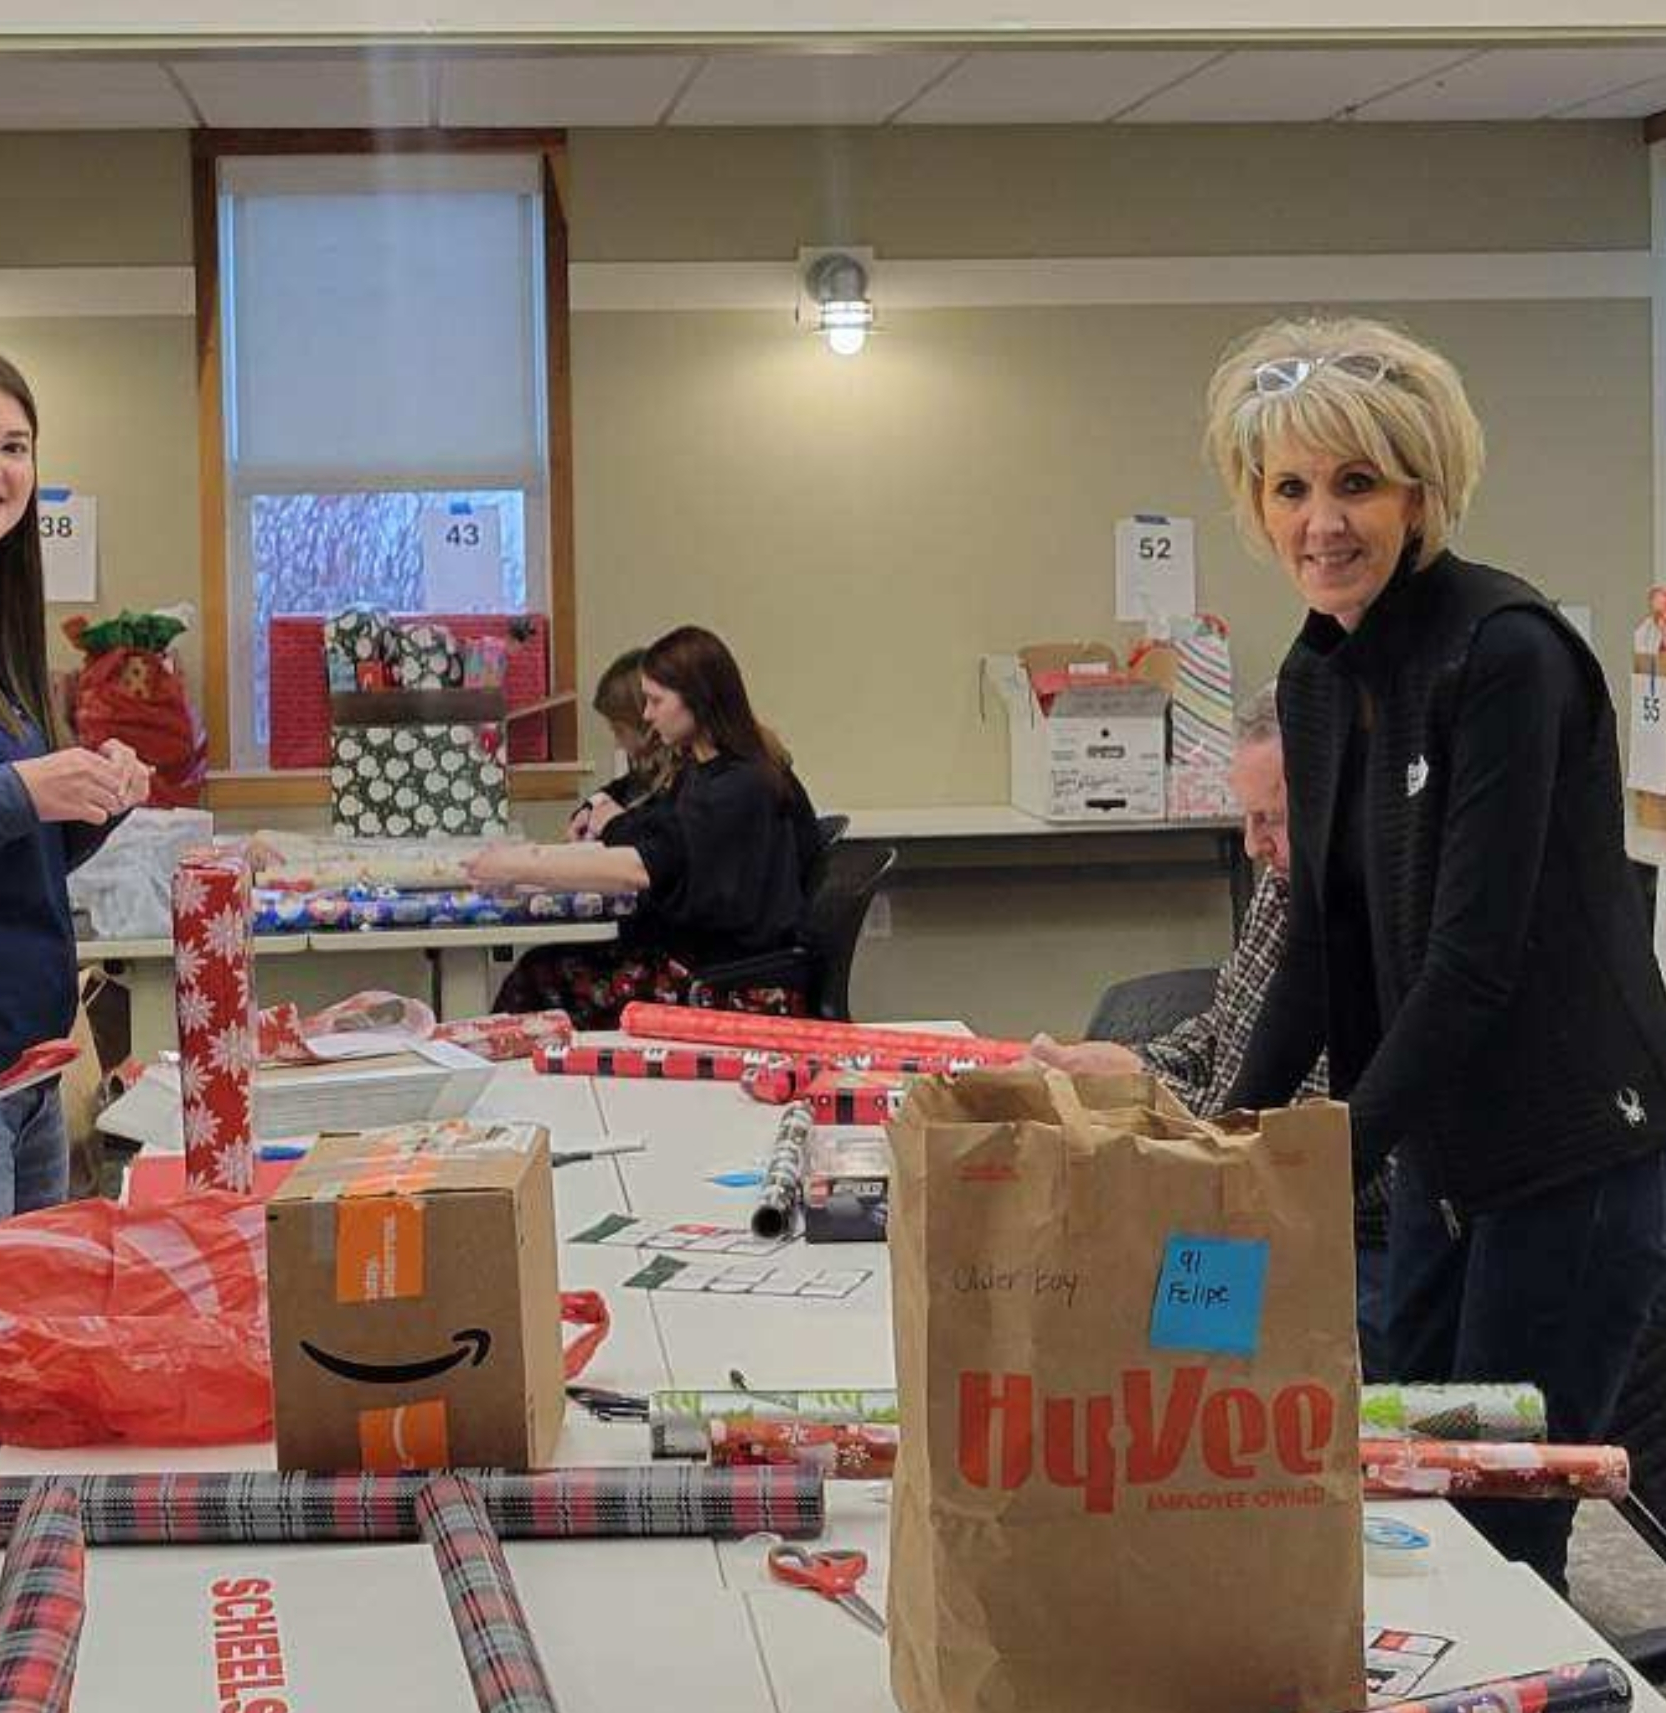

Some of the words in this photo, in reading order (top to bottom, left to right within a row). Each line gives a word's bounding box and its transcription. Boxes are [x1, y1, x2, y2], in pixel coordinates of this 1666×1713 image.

[39, 514, 73, 539] 38
[444, 523, 481, 547] 43
[1137, 536, 1173, 560] 52
[1641, 695, 1661, 724] 55
[1166, 1280, 1231, 1309] Felipe
[211, 1577, 289, 1713] SCHEELS
